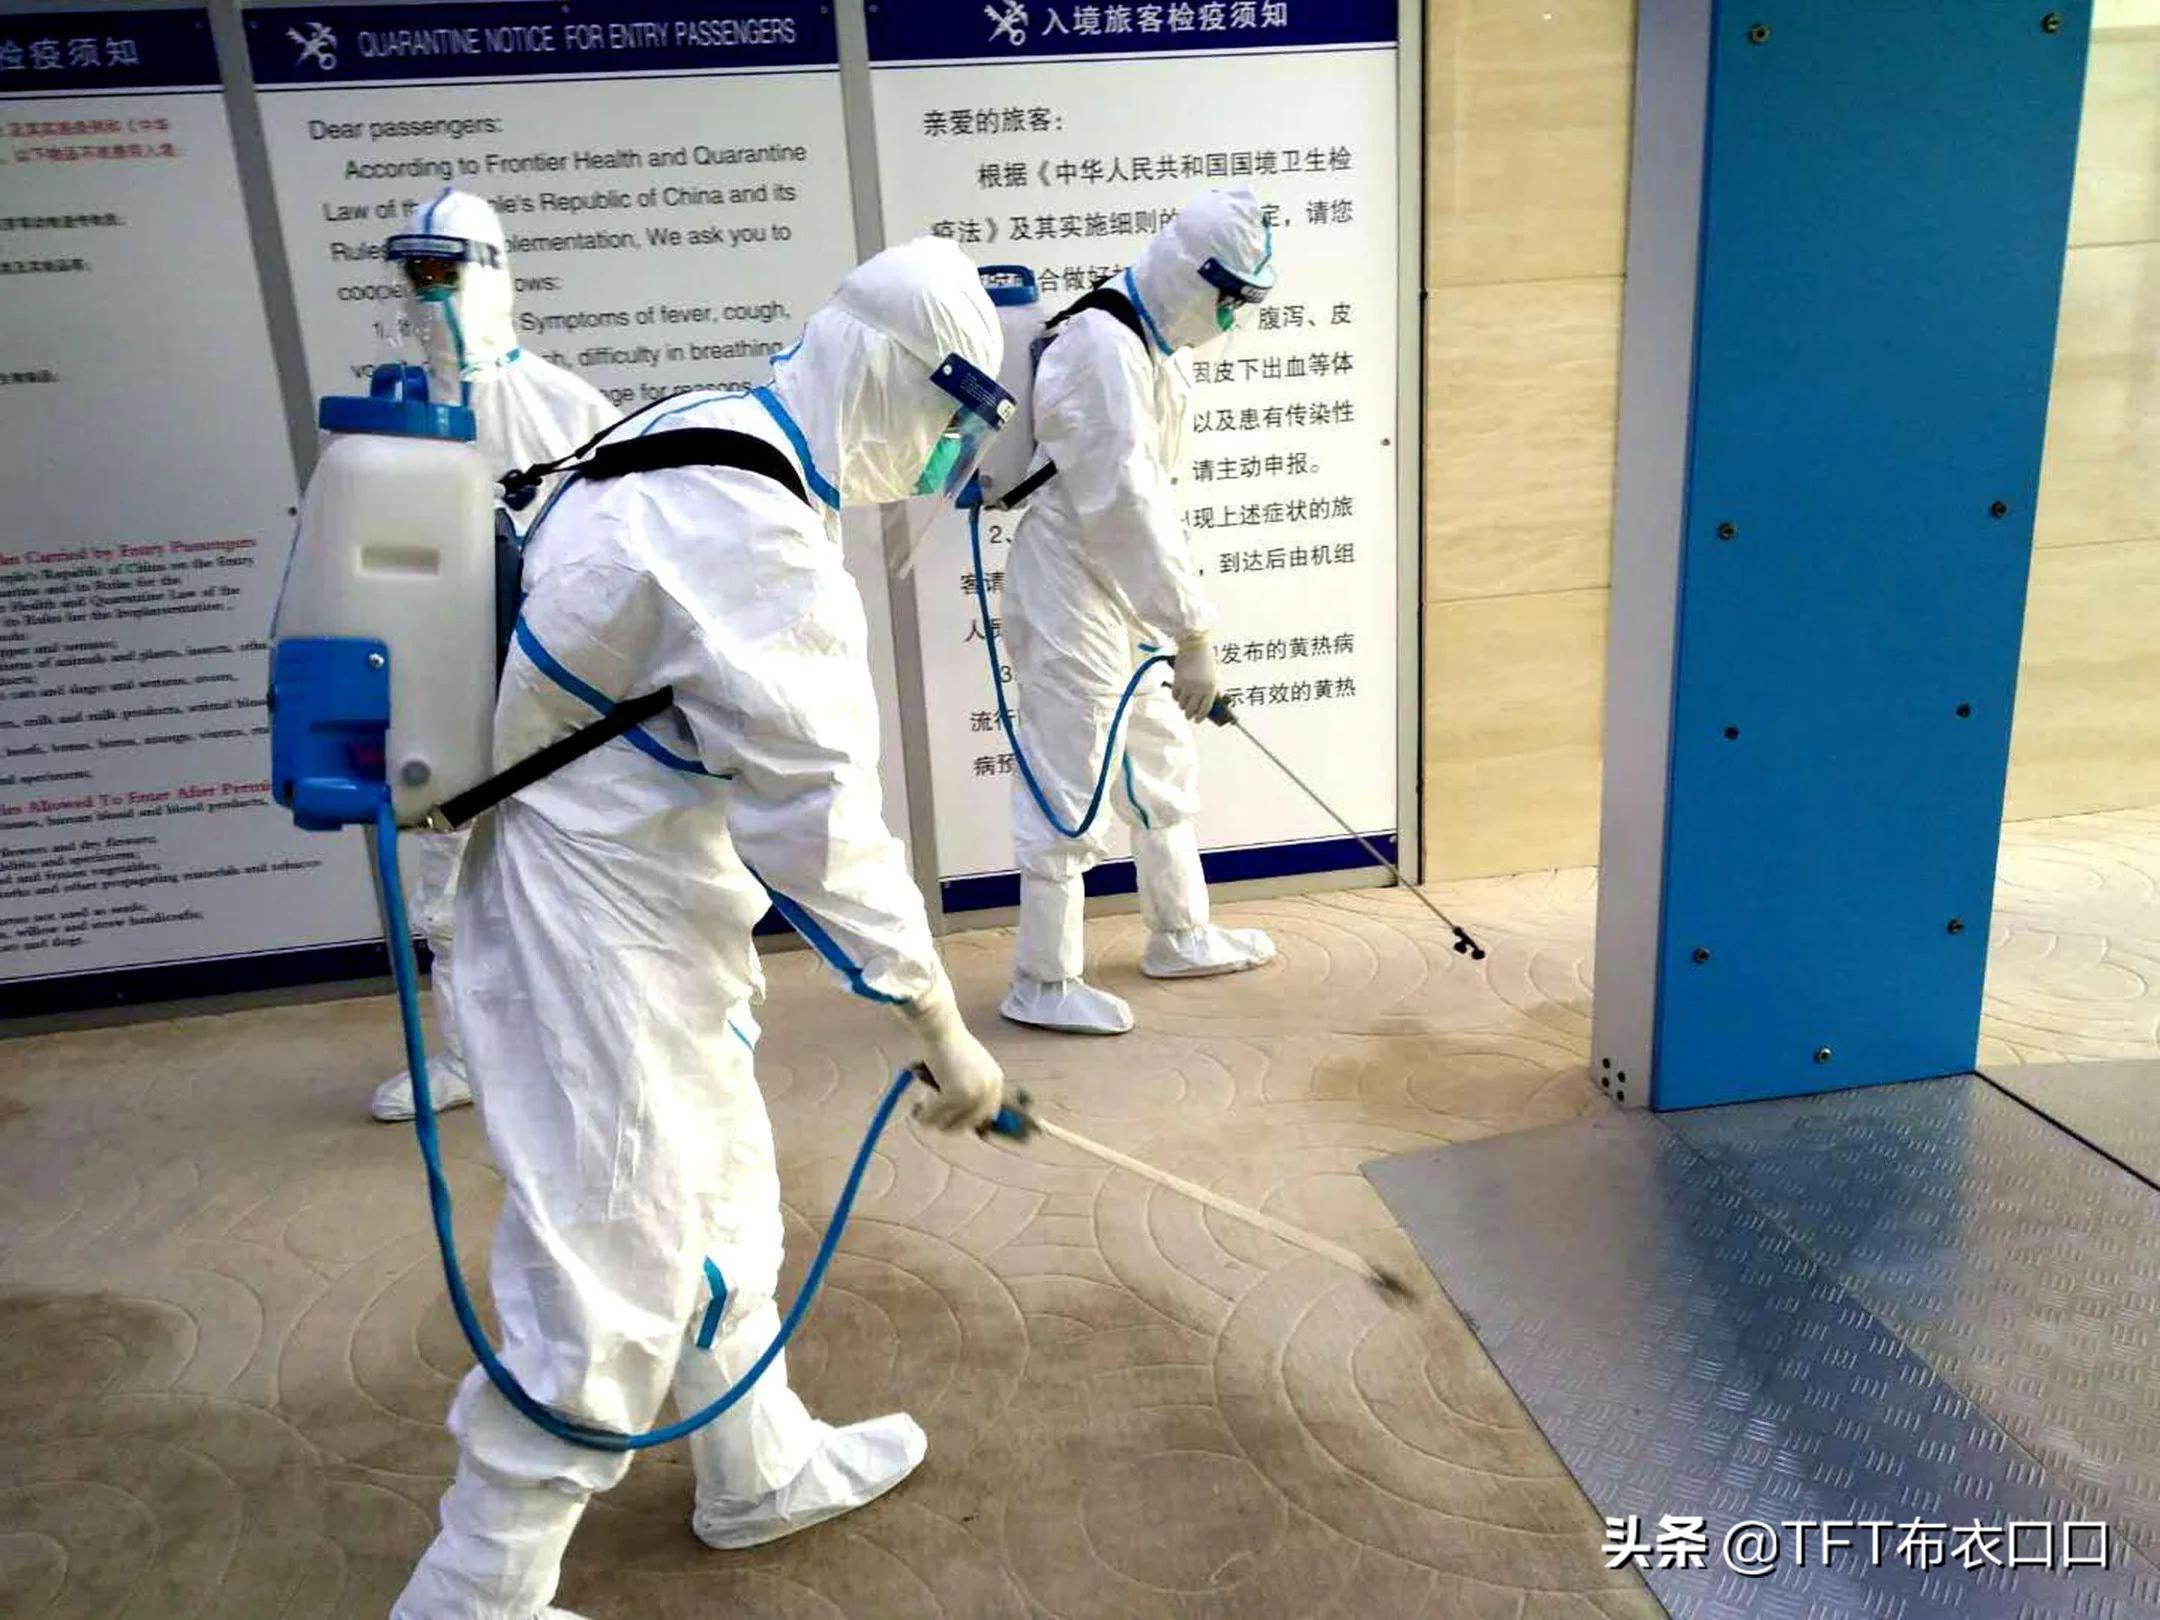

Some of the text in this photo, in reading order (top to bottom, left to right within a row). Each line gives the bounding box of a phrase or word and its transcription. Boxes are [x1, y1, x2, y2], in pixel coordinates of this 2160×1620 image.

[1041, 2, 1288, 36] 入境旅客检疫须知
[358, 18, 797, 57] QUARANTINE NOTICE FOR ENTRY PASSENGERS
[308, 116, 504, 142] Dear passengers:
[344, 144, 807, 181] According to Frontier Health and Quarantine
[978, 145, 1352, 189] 根据《中华人民共和国国境卫生检
[322, 202, 370, 222] Law
[374, 199, 395, 218] of
[540, 189, 632, 213] Republic
[637, 188, 658, 208] of
[662, 186, 724, 207] China
[728, 184, 768, 203] and
[773, 184, 797, 202] its
[645, 228, 683, 247] We
[687, 224, 724, 246] ask
[728, 228, 767, 248] you
[771, 223, 793, 242] to
[520, 310, 631, 335] Symptoms
[635, 306, 655, 325] of
[660, 304, 718, 325] fever,
[722, 299, 791, 323] cough,
[1258, 302, 1352, 330] 腹泻、皮
[578, 346, 661, 367] difficulty
[666, 344, 685, 361] in
[1193, 400, 1355, 434] 以及患有传染性
[1193, 452, 1320, 483] 请主动申报。
[1181, 495, 1354, 529] 现上述症状的旅
[1213, 633, 1355, 665] 发布的黄热病
